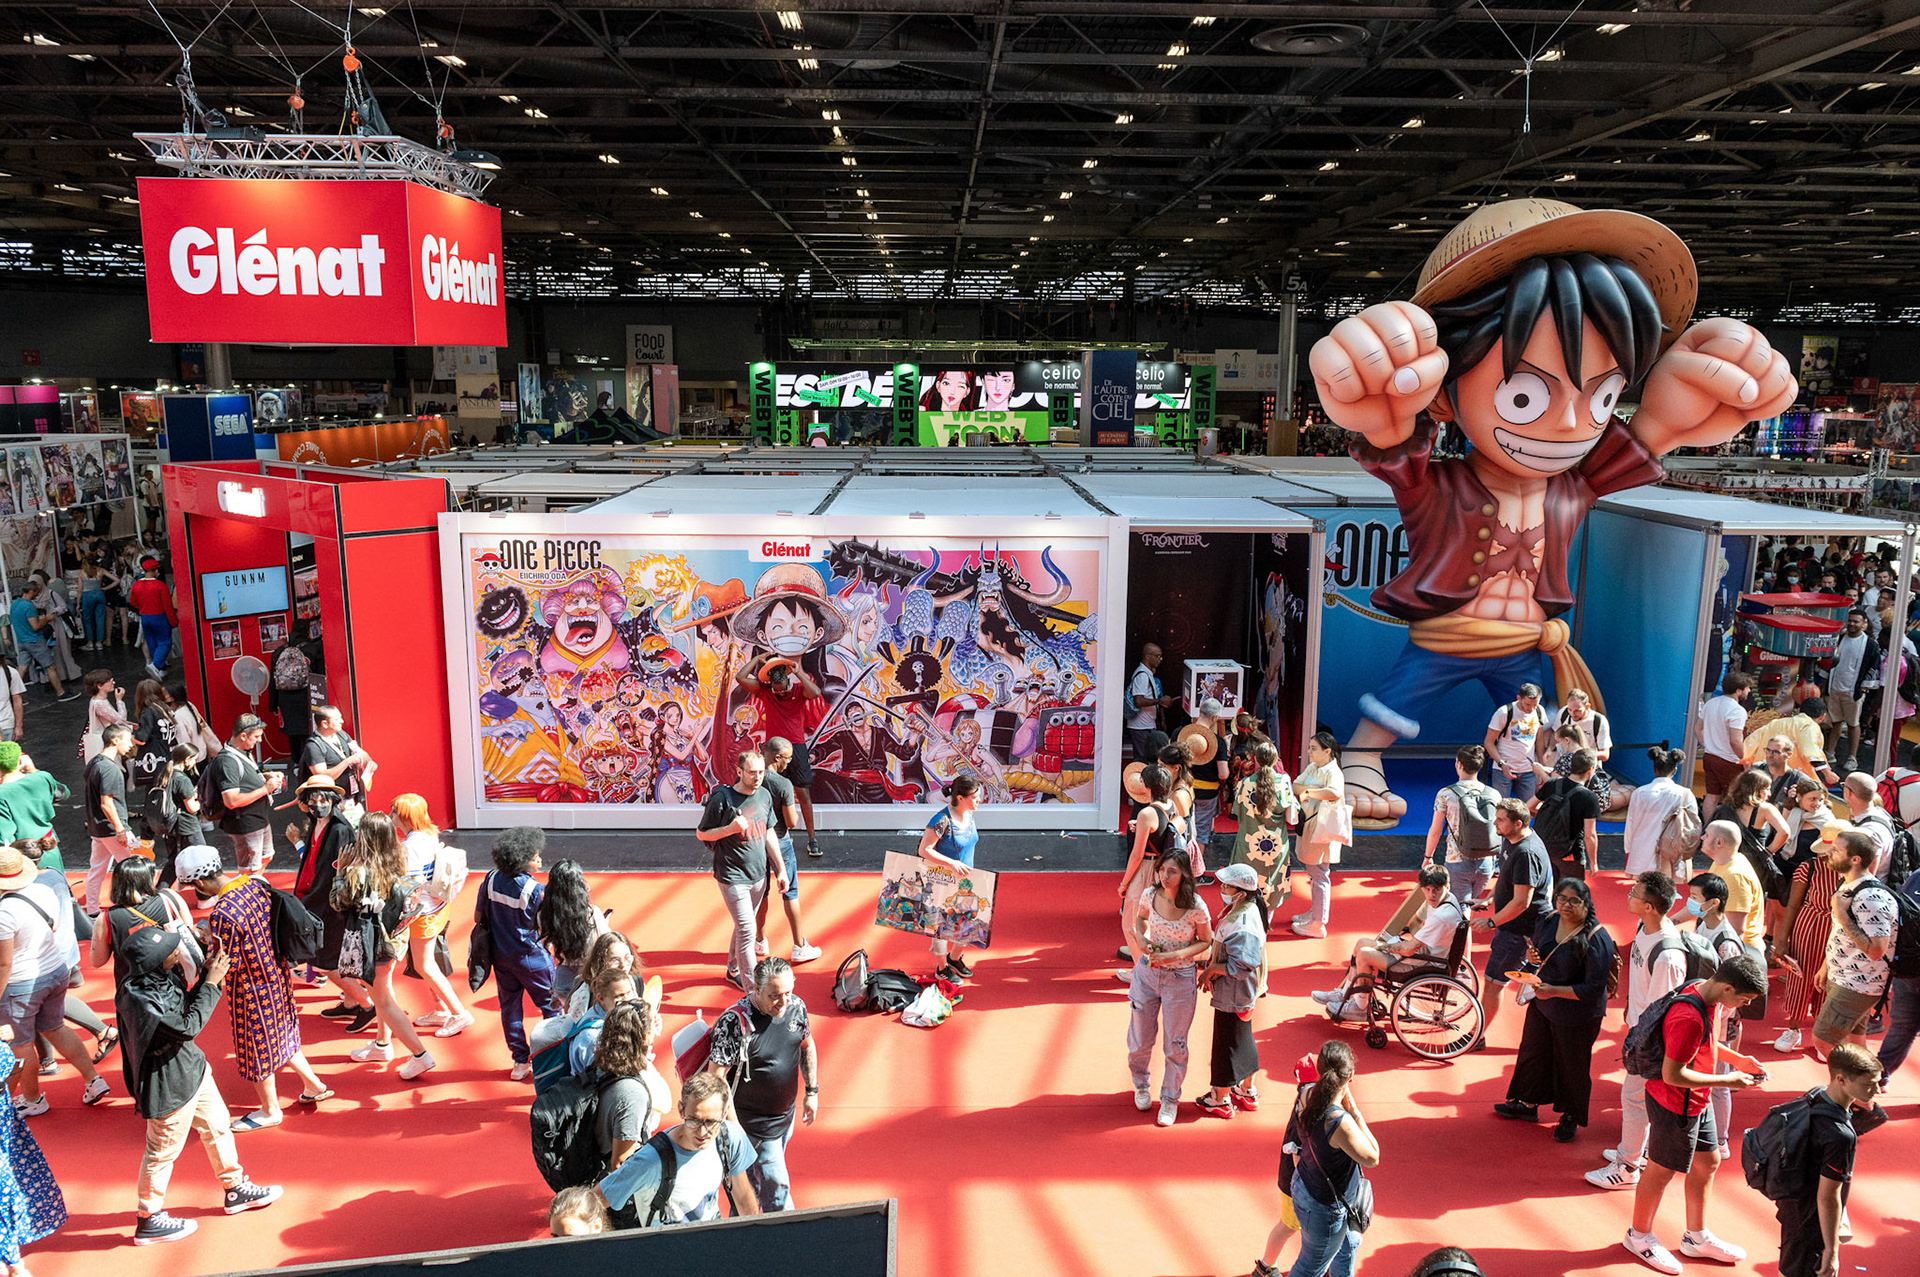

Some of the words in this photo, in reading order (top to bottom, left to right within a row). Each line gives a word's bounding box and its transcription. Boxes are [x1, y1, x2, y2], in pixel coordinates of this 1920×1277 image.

[169, 226, 386, 296] Glénat
[421, 234, 498, 306] Glénat
[1286, 275, 1308, 291] 5A
[634, 333, 665, 350] FOOD
[635, 349, 665, 360] Court
[1042, 366, 1081, 379] celio
[1136, 366, 1165, 380] celio
[1094, 385, 1128, 395] L'AUTRE
[1092, 399, 1133, 421] CIEL
[213, 414, 249, 436] SEGA
[499, 539, 538, 570] ONE
[761, 541, 811, 557] Glénat
[225, 571, 266, 587] GUNNM
[519, 572, 550, 580] EIICHIRO
